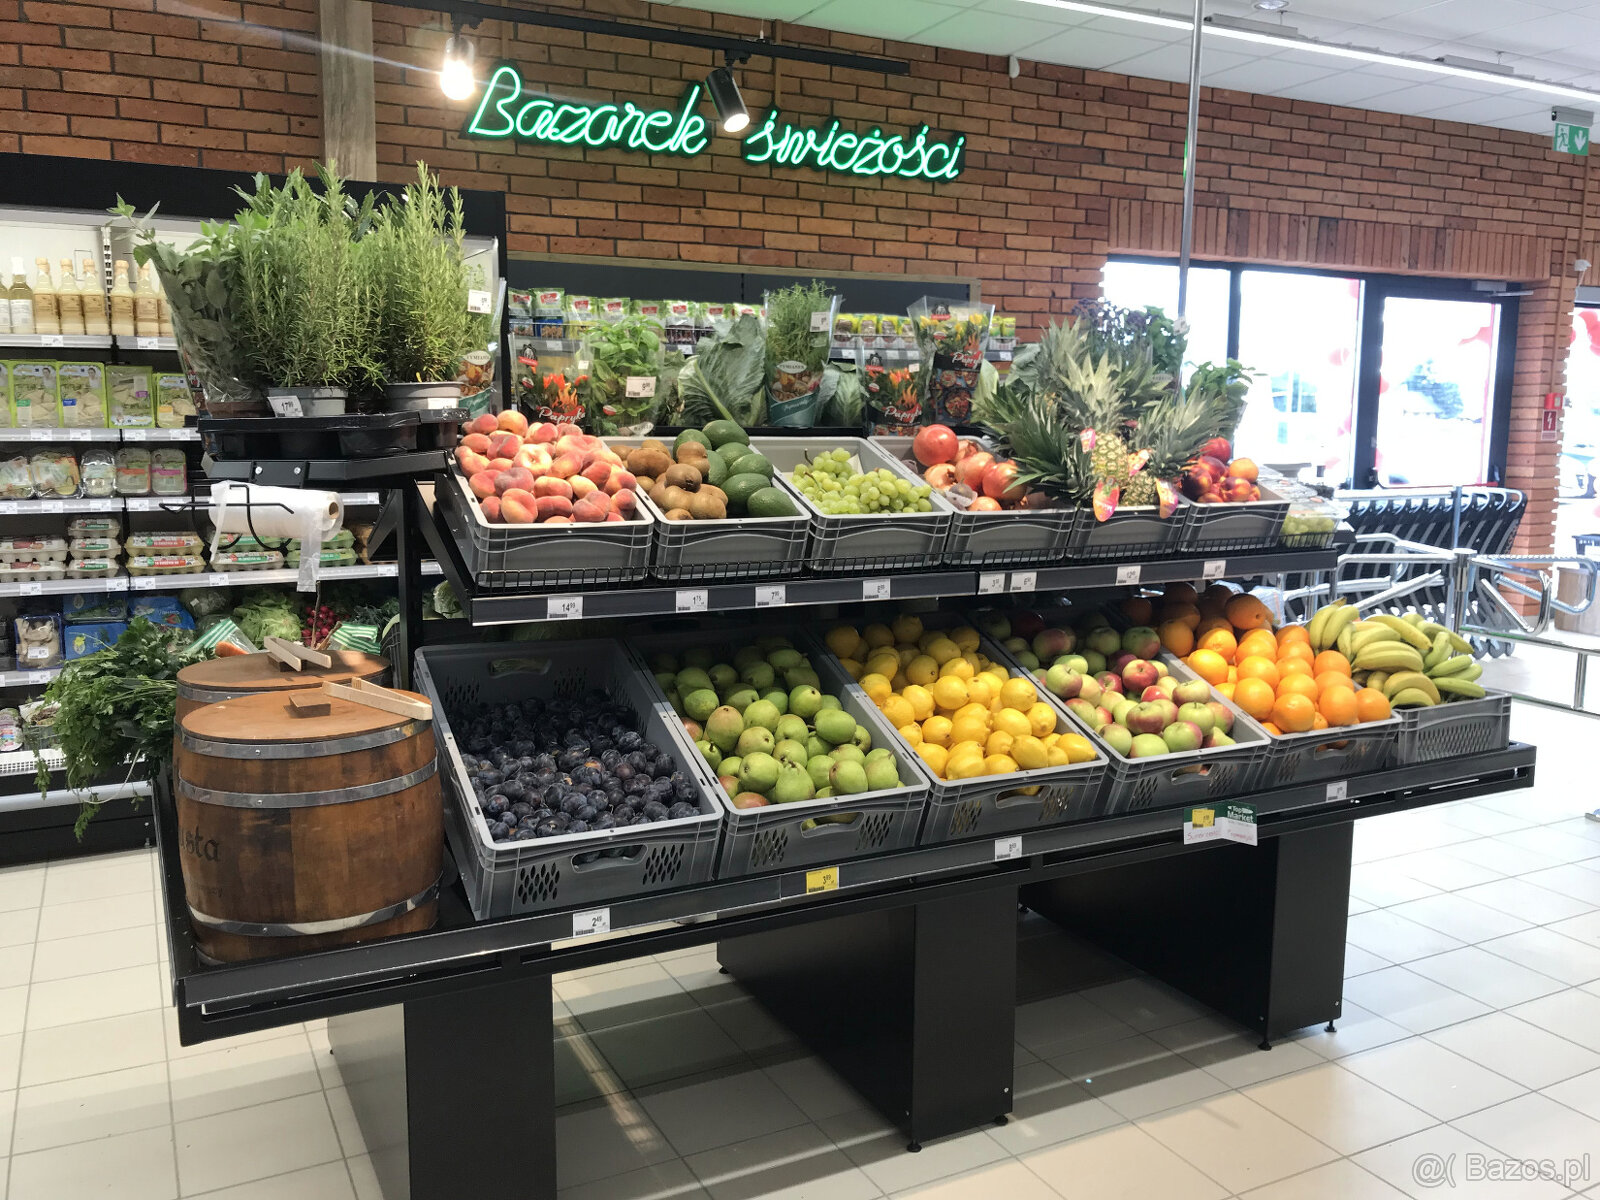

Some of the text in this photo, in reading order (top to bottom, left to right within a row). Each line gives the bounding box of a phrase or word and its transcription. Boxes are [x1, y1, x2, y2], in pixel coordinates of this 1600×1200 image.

[467, 65, 966, 179] Bazarek świeżości
[1227, 810, 1254, 823] Market
